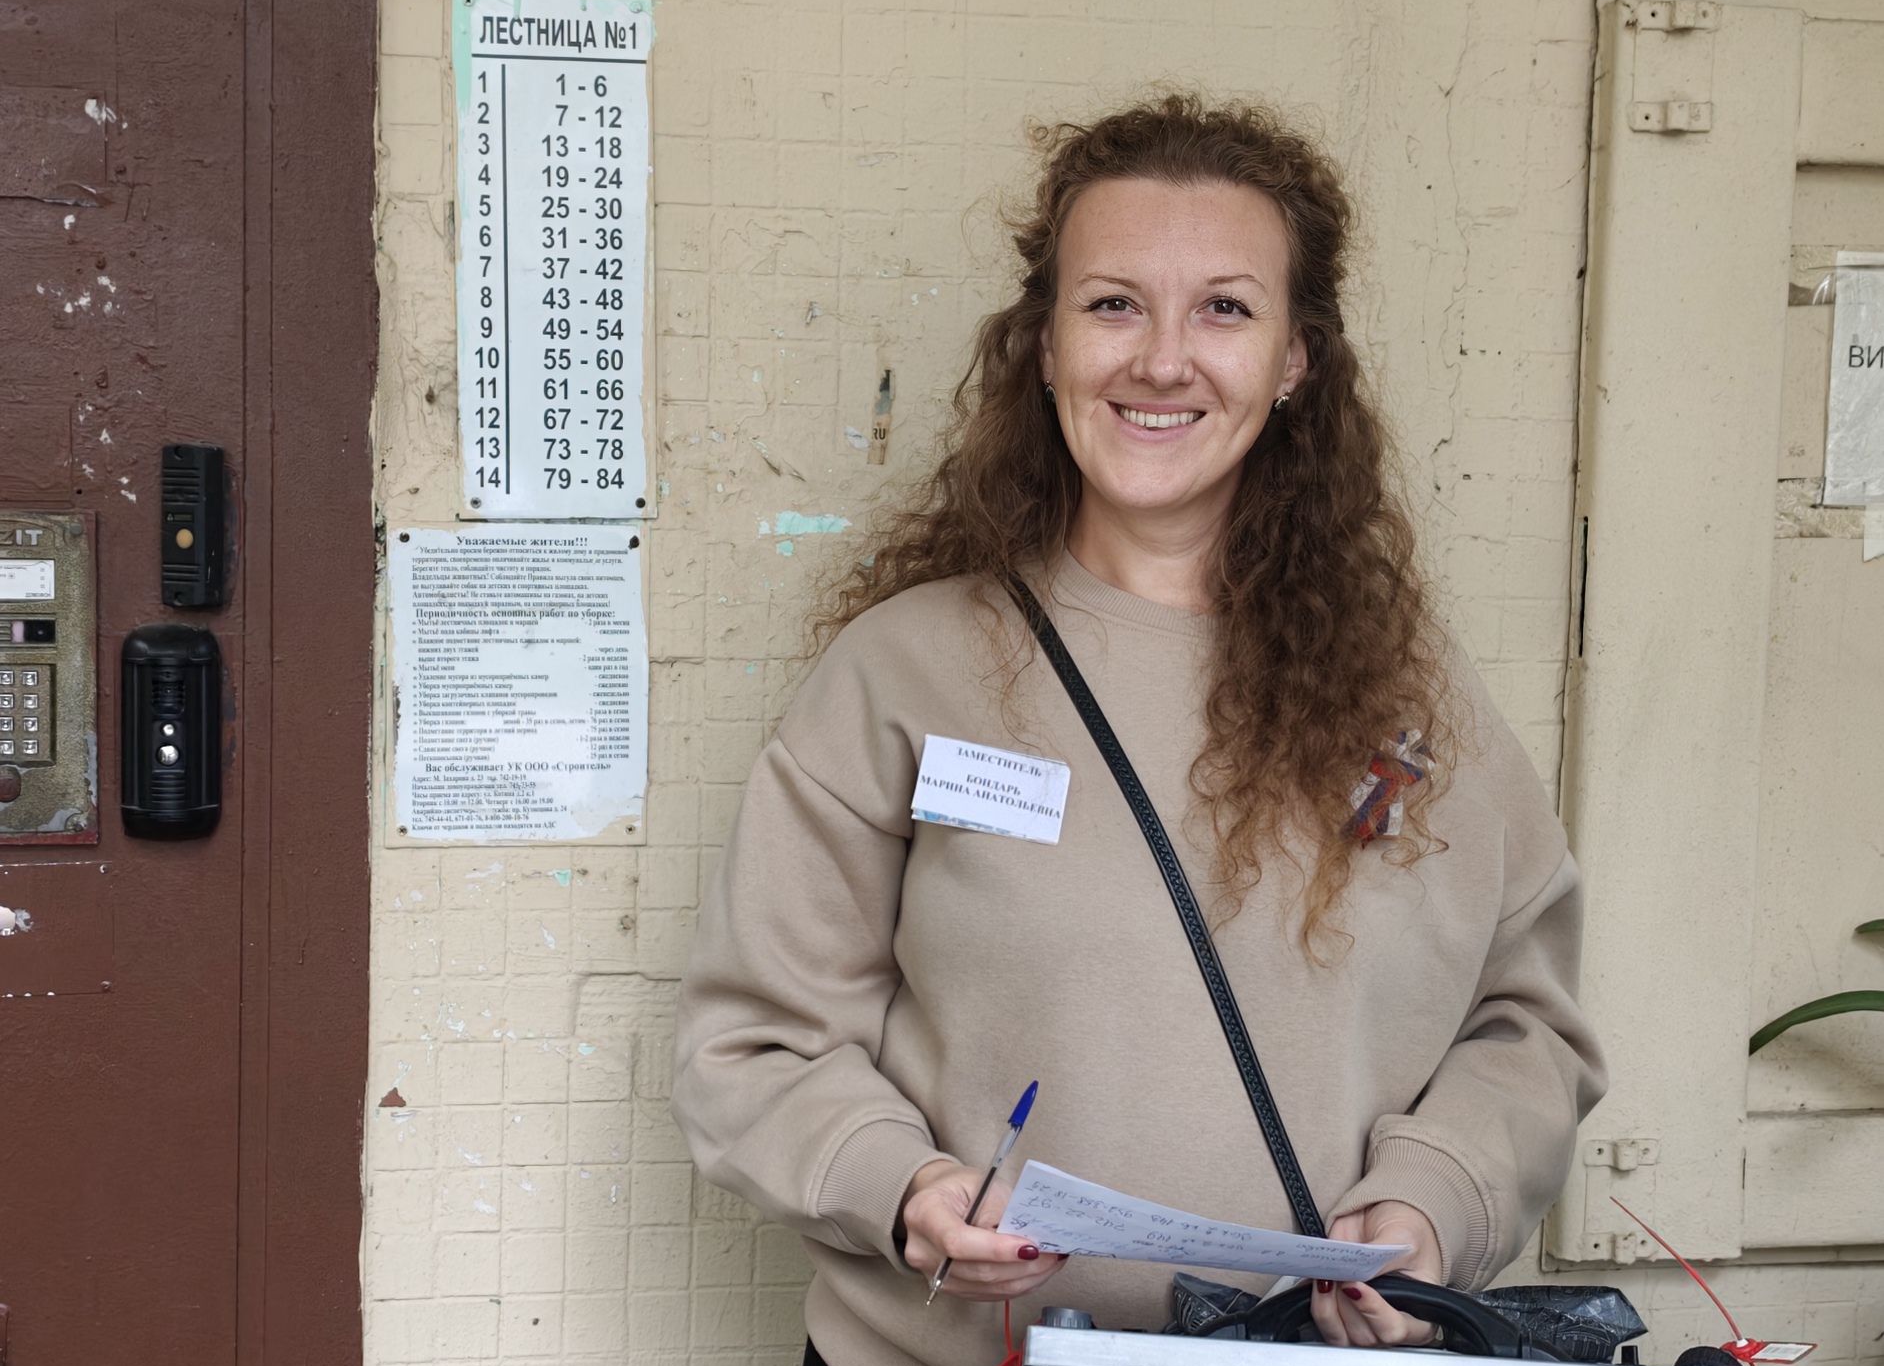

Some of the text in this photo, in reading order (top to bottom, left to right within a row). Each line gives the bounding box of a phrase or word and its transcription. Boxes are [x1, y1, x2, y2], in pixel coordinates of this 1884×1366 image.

[479, 15, 637, 54] ЛЕСТНИЦА №1
[478, 71, 487, 94] 1
[555, 73, 566, 96] 1
[593, 75, 608, 98] 6
[477, 101, 490, 125] 2
[555, 104, 569, 127] 7
[595, 105, 622, 129] 12
[478, 132, 490, 156] 3
[541, 134, 569, 158] 13
[595, 136, 622, 159] 18
[477, 163, 492, 186] 4
[541, 165, 569, 188] 19
[594, 166, 623, 189] 24
[479, 194, 492, 217] 5
[541, 195, 570, 219] 25
[594, 197, 623, 220] 30
[479, 224, 492, 248] 6
[542, 226, 568, 249] 31
[595, 227, 623, 251] 36
[479, 255, 492, 278] 7
[542, 256, 570, 280] 37
[594, 257, 624, 281] 42
[480, 285, 493, 309] 8
[542, 287, 571, 310] 43
[594, 288, 624, 311] 48
[480, 316, 493, 339] 9
[542, 317, 571, 341] 49
[596, 318, 625, 341] 54
[474, 346, 500, 369] 10
[543, 348, 572, 371] 55
[596, 348, 624, 371] 60
[475, 376, 498, 399] 11
[543, 377, 570, 400] 61
[596, 378, 624, 401] 66
[475, 406, 501, 429] 12
[543, 407, 572, 430] 67
[595, 408, 624, 431] 72
[475, 436, 501, 459] 13
[543, 438, 572, 461] 73
[596, 438, 624, 461] 78
[475, 466, 501, 488] 14
[543, 467, 572, 490] 79
[596, 467, 625, 490] 84
[456, 536, 588, 546] Уважаемые жители!!!
[412, 573, 450, 581] Владельцы
[528, 574, 553, 582] Правила
[415, 608, 489, 619] Периодичность
[491, 609, 537, 618] основных
[539, 608, 565, 619] работ
[581, 608, 615, 620] уборке:
[425, 762, 611, 774] Вас обслуживает УК ООО «Строитель»
[956, 746, 1042, 777] ЗАМЕСТИТЕЛЬ
[920, 775, 1062, 819] МАРИНА АНАТОЛЬЕВНА
[966, 774, 1021, 796] БОНДАРЬ
